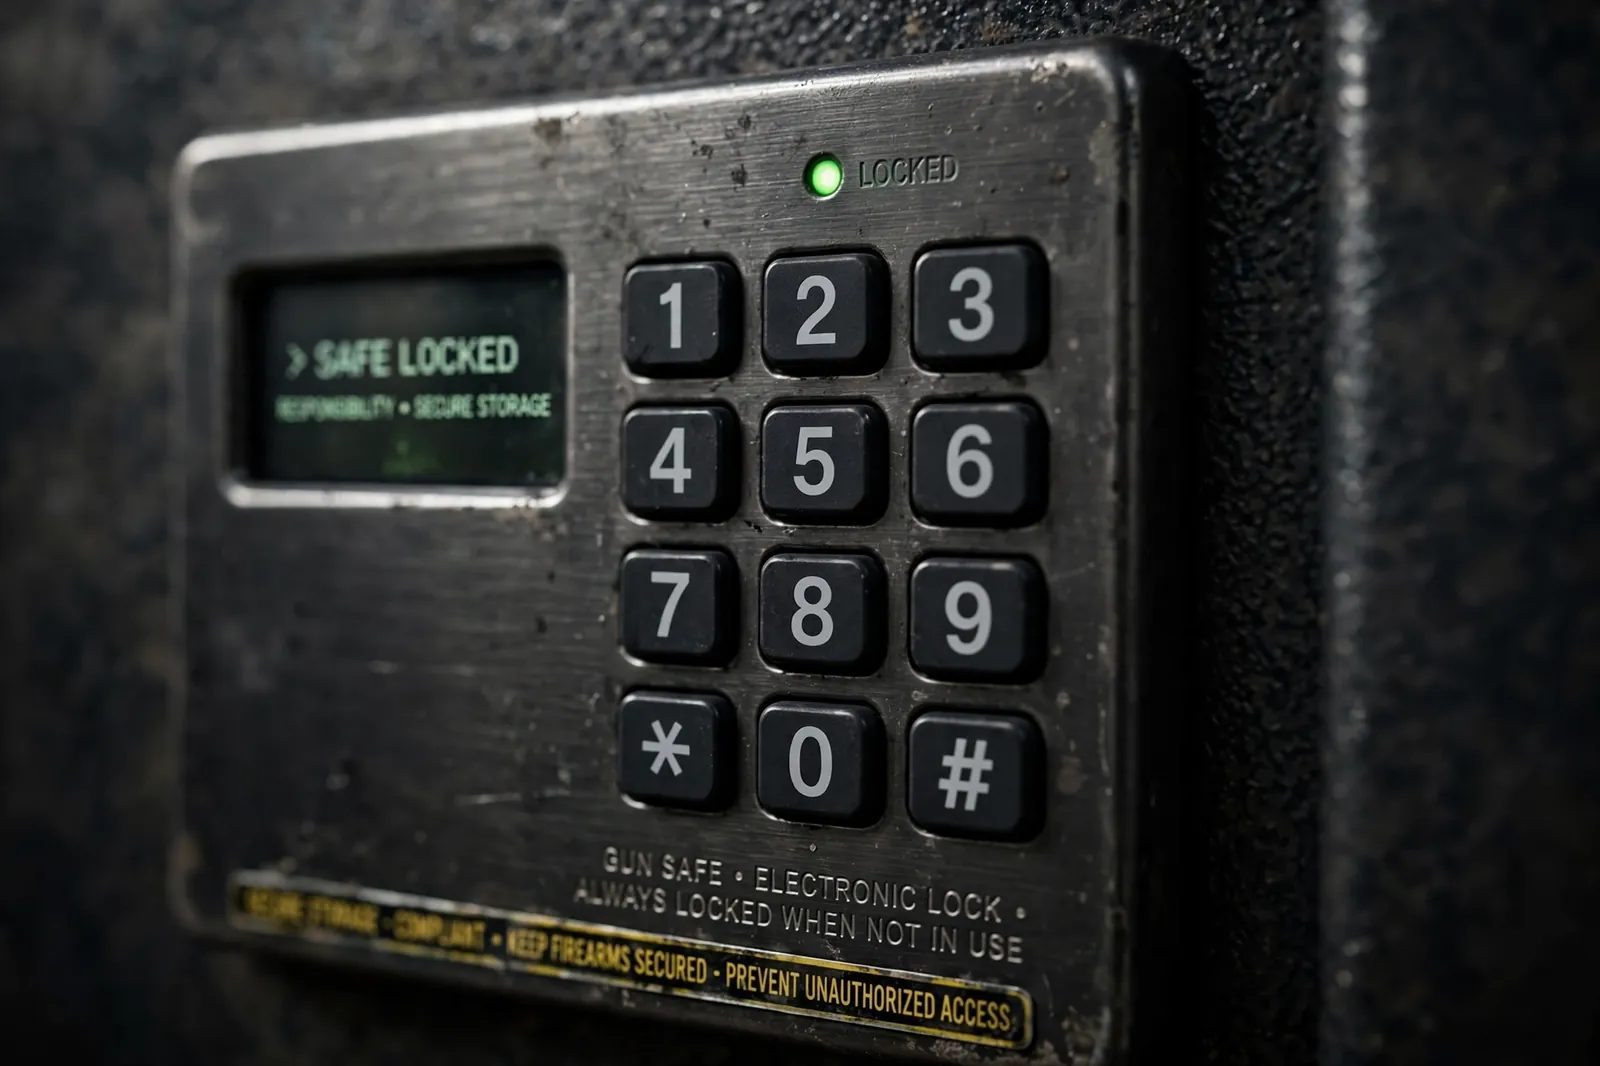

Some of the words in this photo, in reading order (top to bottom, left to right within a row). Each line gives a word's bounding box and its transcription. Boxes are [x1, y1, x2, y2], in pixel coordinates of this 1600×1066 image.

[859, 154, 959, 189] LOCKED
[659, 282, 682, 349] 1
[795, 274, 837, 346] 2
[948, 267, 995, 342] 3
[313, 337, 393, 380] SAFE
[398, 335, 519, 376] LOCKED
[413, 394, 474, 420] SECURE
[477, 393, 551, 418] STORAGE
[649, 427, 692, 494] 4
[793, 426, 835, 496] 5
[946, 423, 993, 498] 6
[650, 571, 690, 638] 7
[790, 575, 834, 647] 8
[944, 580, 992, 656] 9
[788, 725, 833, 798] 0
[938, 737, 994, 812] #
[574, 877, 667, 914] ALWAYS
[676, 892, 772, 928] LOCKED
[782, 904, 856, 940] WHEN
[867, 916, 922, 948] NOT
[931, 925, 957, 954] IN
[969, 930, 1023, 964] USE
[603, 846, 652, 877] GUN
[662, 853, 723, 886] SAFE
[755, 867, 916, 911] ELECTRONIC
[928, 887, 1002, 923] LOCK
[506, 928, 548, 959] KEEP
[550, 934, 630, 973] FIREARMS
[634, 948, 707, 985] SECURED
[725, 961, 800, 999] PREVENT
[804, 973, 936, 1020] UNAUTHORIZED
[940, 995, 1012, 1031] ACCESS
